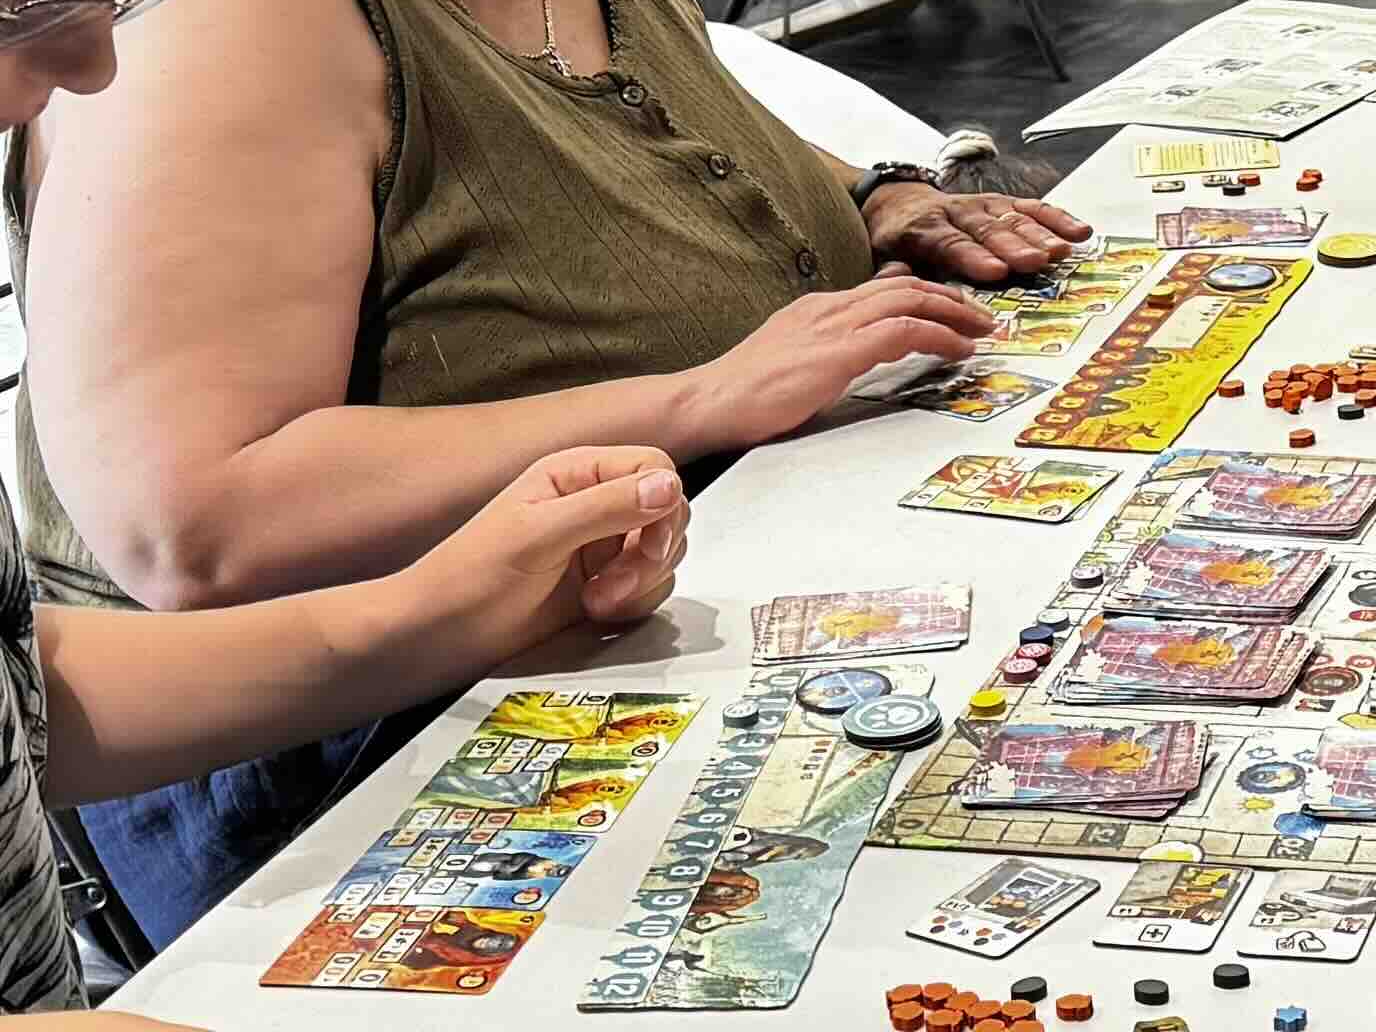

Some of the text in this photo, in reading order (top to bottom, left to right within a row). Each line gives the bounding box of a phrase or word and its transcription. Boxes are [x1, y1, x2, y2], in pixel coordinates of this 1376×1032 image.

[738, 738, 765, 747] 3
[723, 760, 752, 771] 4
[712, 788, 741, 797] 5
[699, 813, 726, 823] 6
[685, 840, 714, 848] 7
[670, 866, 700, 875] 8
[652, 895, 683, 905] 9
[637, 920, 673, 936] 10
[621, 949, 657, 964] 11
[603, 979, 640, 995] 12
